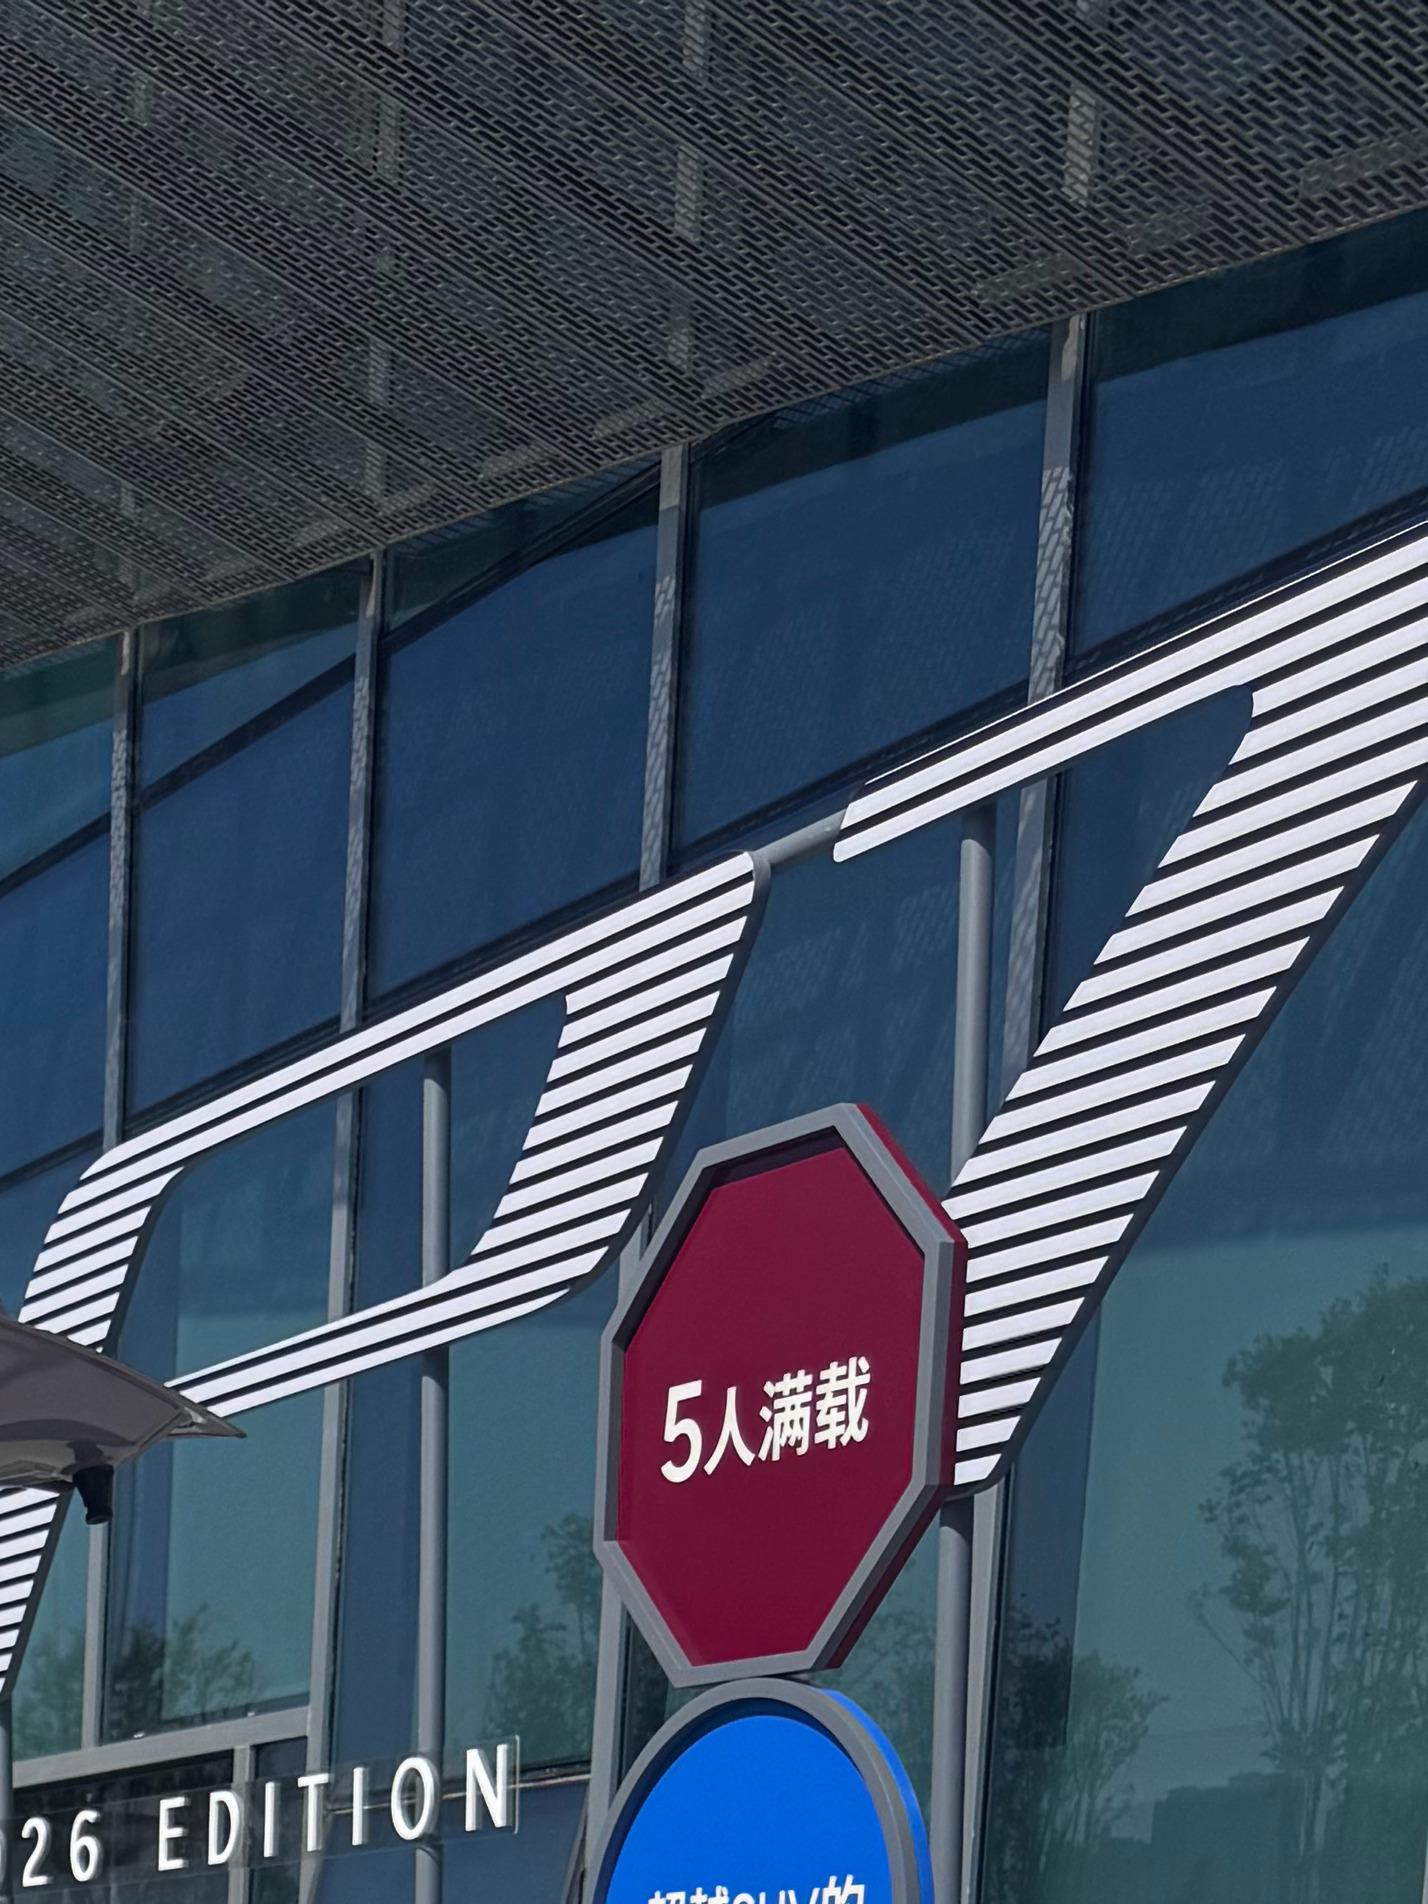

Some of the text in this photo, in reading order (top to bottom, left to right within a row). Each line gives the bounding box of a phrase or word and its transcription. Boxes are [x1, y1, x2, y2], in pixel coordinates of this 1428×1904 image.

[659, 1354, 872, 1486] 5人满载
[156, 1743, 511, 1873] EDITION
